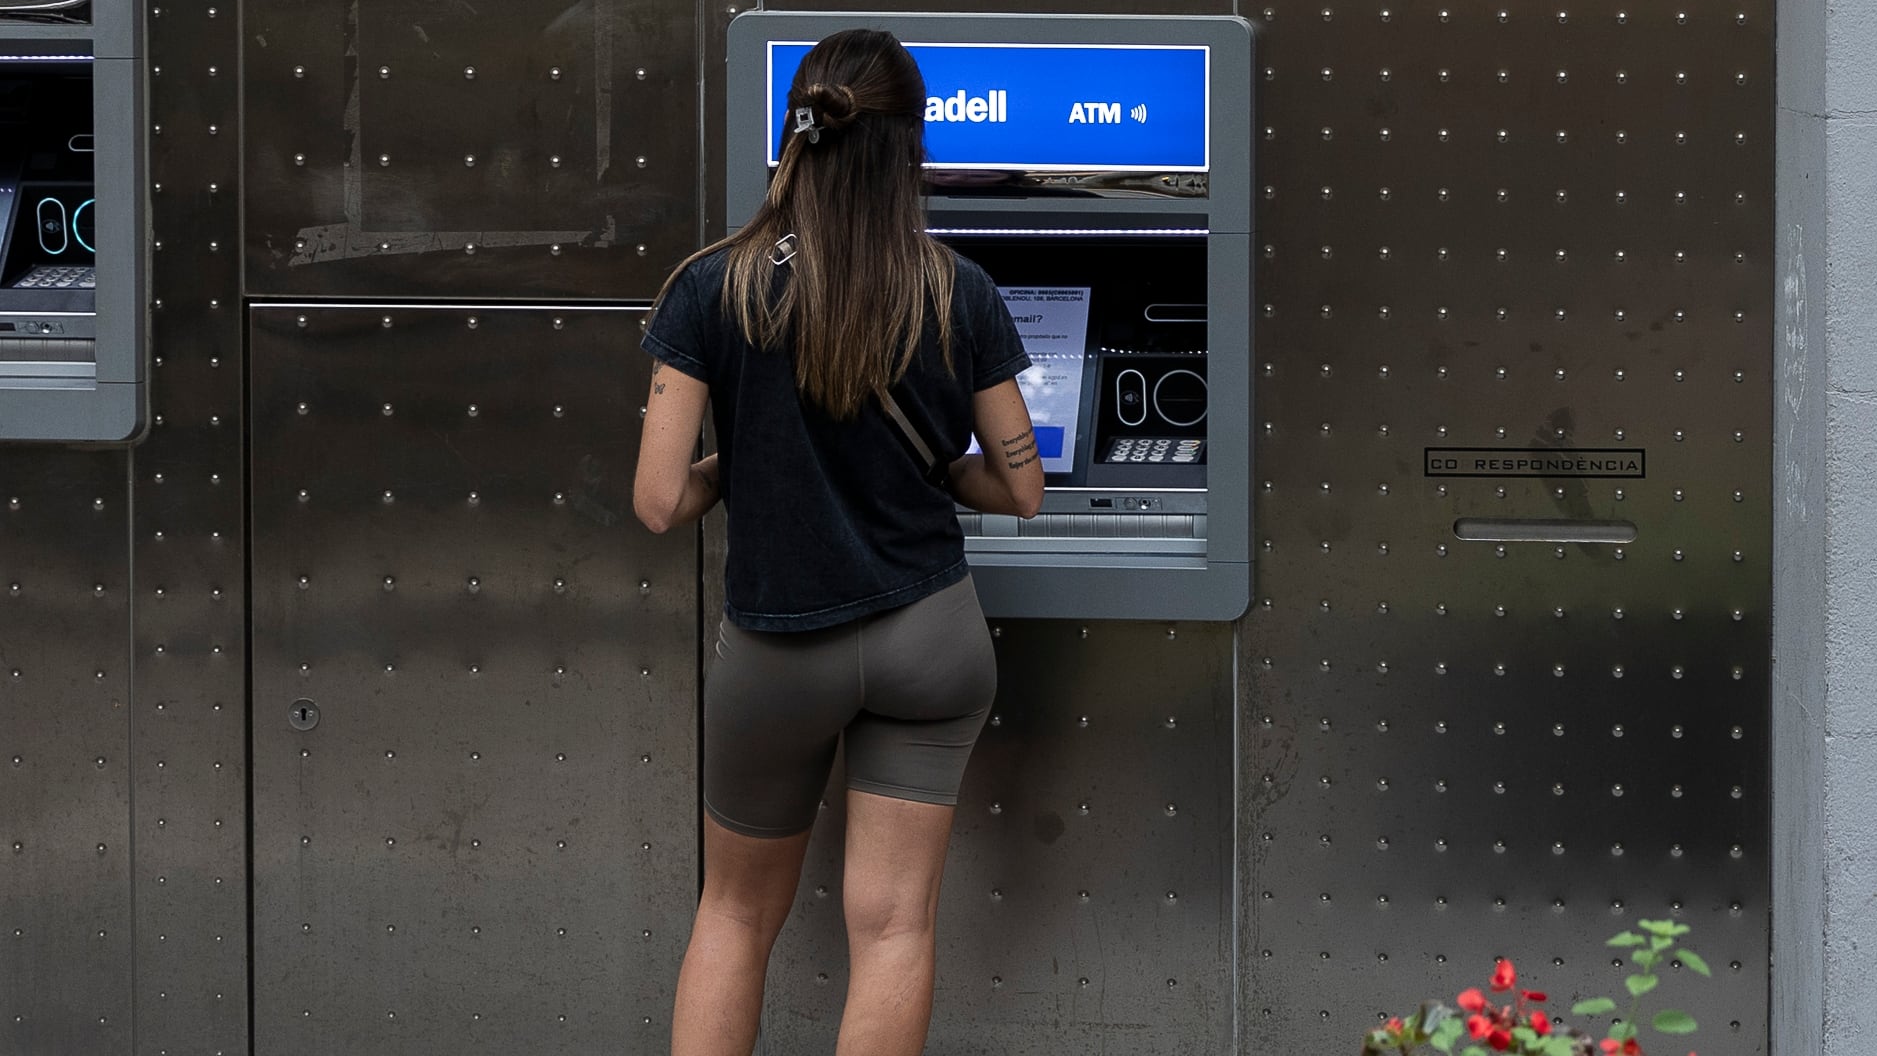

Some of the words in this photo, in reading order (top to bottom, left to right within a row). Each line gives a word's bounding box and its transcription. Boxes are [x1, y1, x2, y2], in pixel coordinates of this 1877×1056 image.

[923, 89, 1007, 123] adell
[1068, 102, 1122, 124] ATM
[1014, 314, 1043, 323] mail?
